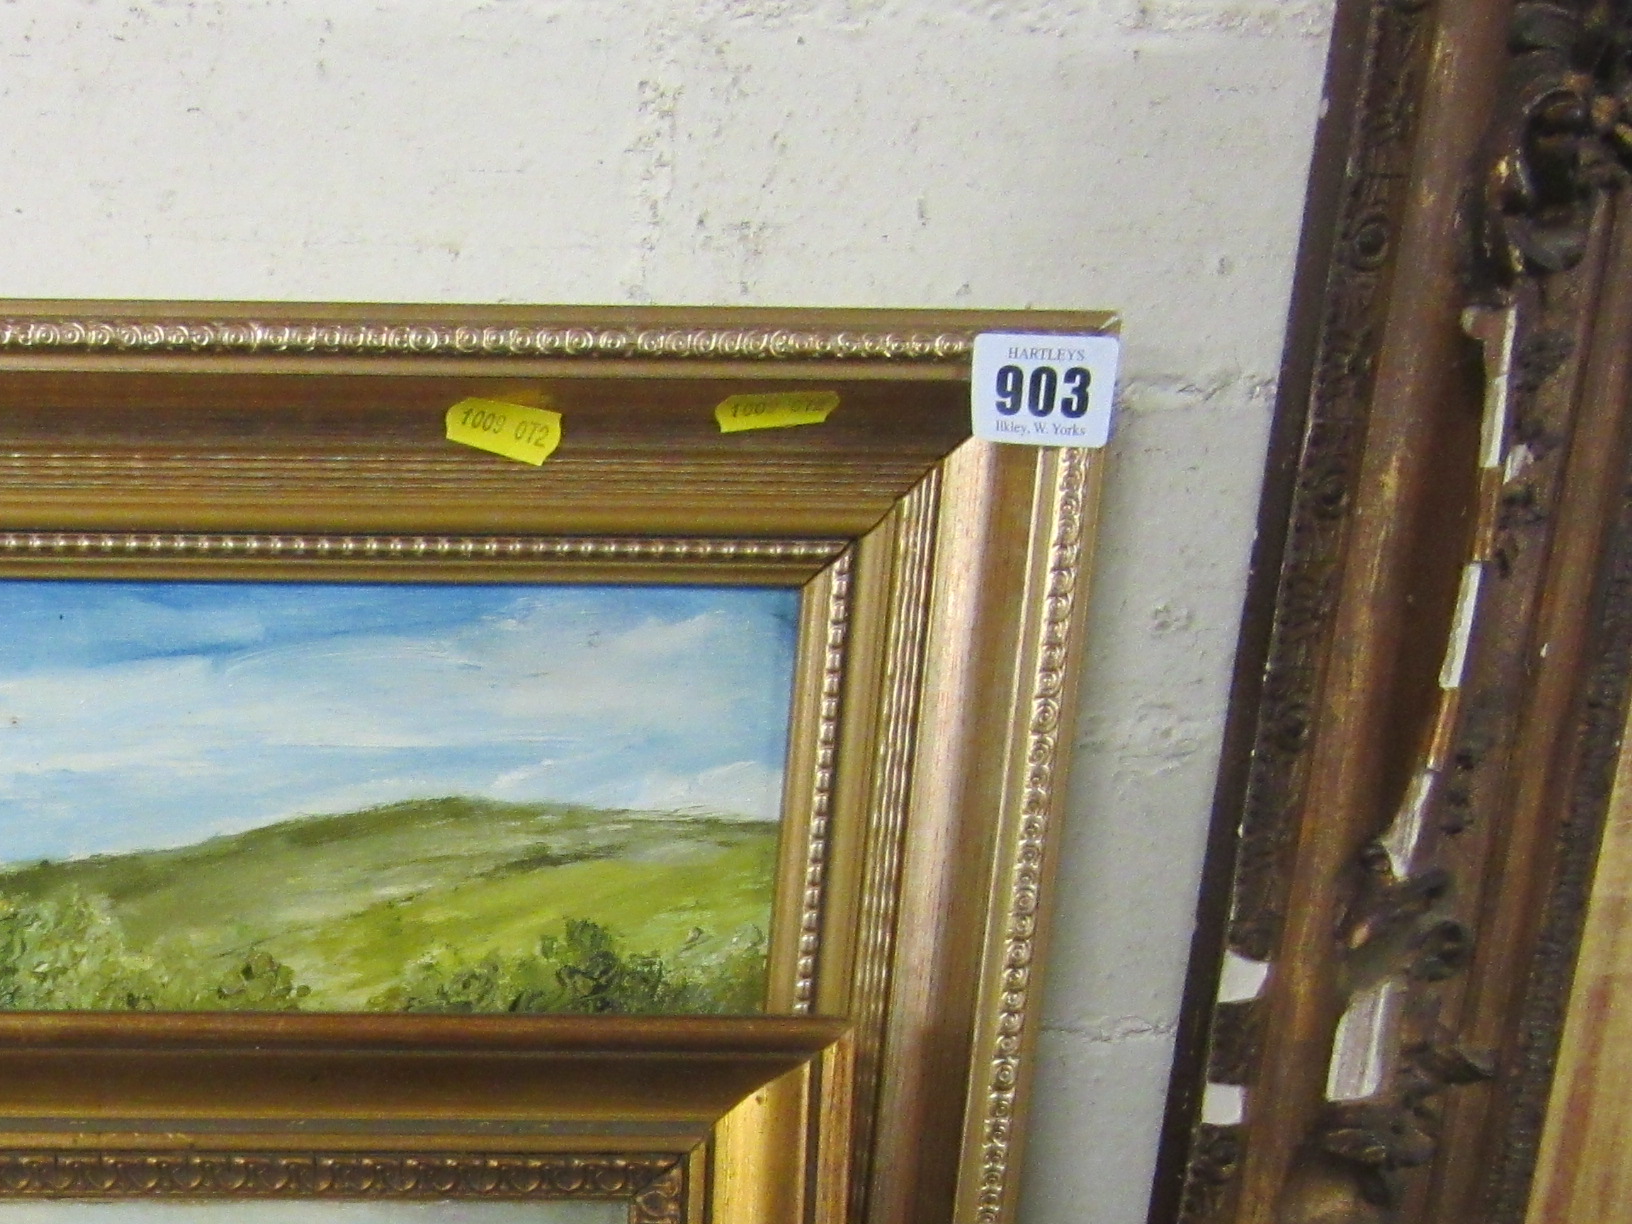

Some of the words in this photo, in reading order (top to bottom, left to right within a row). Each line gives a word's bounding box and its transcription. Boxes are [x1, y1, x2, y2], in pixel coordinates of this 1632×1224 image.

[1008, 347, 1085, 361] HARTLEYS
[995, 364, 1091, 419] 903
[995, 420, 1030, 436] Ilkley,
[1033, 422, 1049, 435] W.
[1052, 423, 1086, 436] Yorks
